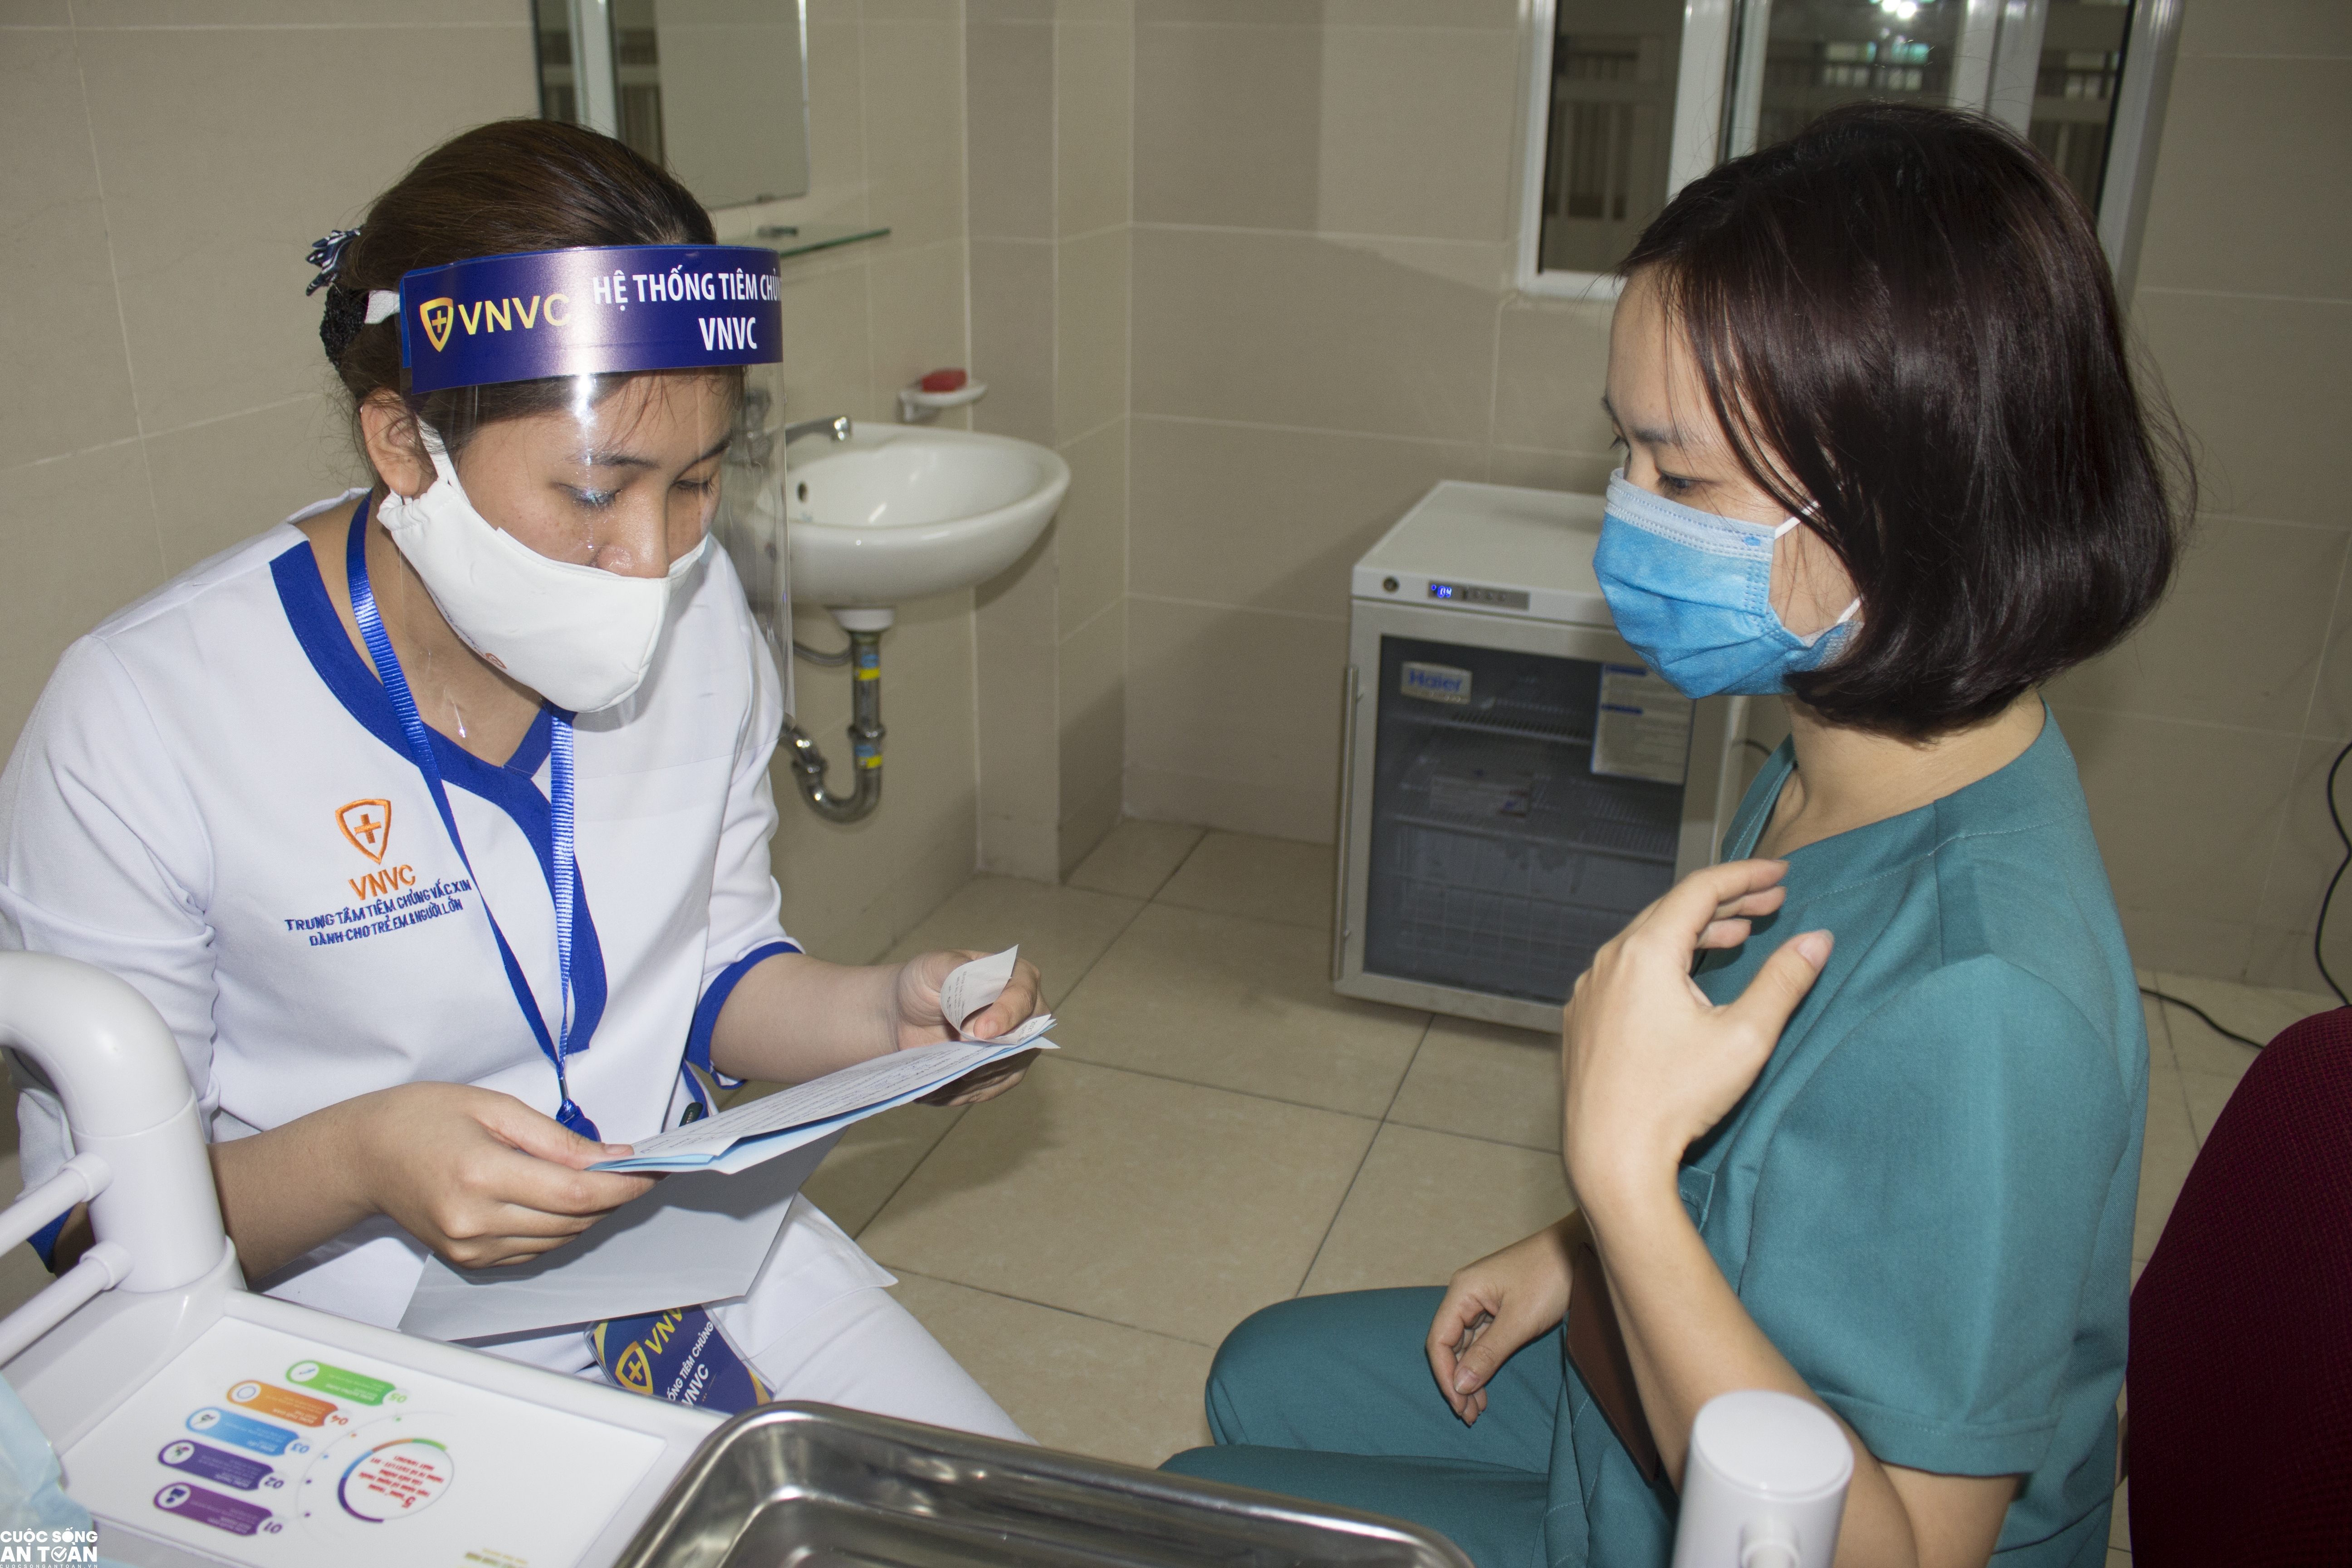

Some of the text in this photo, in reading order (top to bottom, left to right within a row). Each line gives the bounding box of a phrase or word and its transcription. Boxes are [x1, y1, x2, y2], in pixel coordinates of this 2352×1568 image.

[593, 265, 781, 311] HỆ THỐNG TIÊM CHỦN
[458, 293, 571, 335] VNVC
[699, 317, 758, 350] VNVC
[1409, 669, 1463, 692] Haier
[348, 865, 416, 900] VNVC
[284, 914, 335, 931] TRUNG
[335, 906, 366, 924] TÂM
[365, 898, 397, 917] TIÊM
[397, 888, 431, 909] CHỦNG
[309, 932, 344, 946] DÀNH
[346, 925, 370, 941] CHO
[371, 914, 393, 935] TRẺ
[393, 914, 408, 930] EM
[441, 896, 463, 914] LỚN
[644, 1307, 682, 1354] VNV
[667, 1321, 714, 1401] ỐNG TIÊM CHỦNG
[389, 1392, 407, 1403] 05
[681, 1363, 708, 1406] VNVC
[330, 1415, 348, 1426] 04
[290, 1442, 310, 1454] 03
[264, 1476, 284, 1489] 02
[402, 1496, 416, 1509] 5
[263, 1521, 282, 1534] 01
